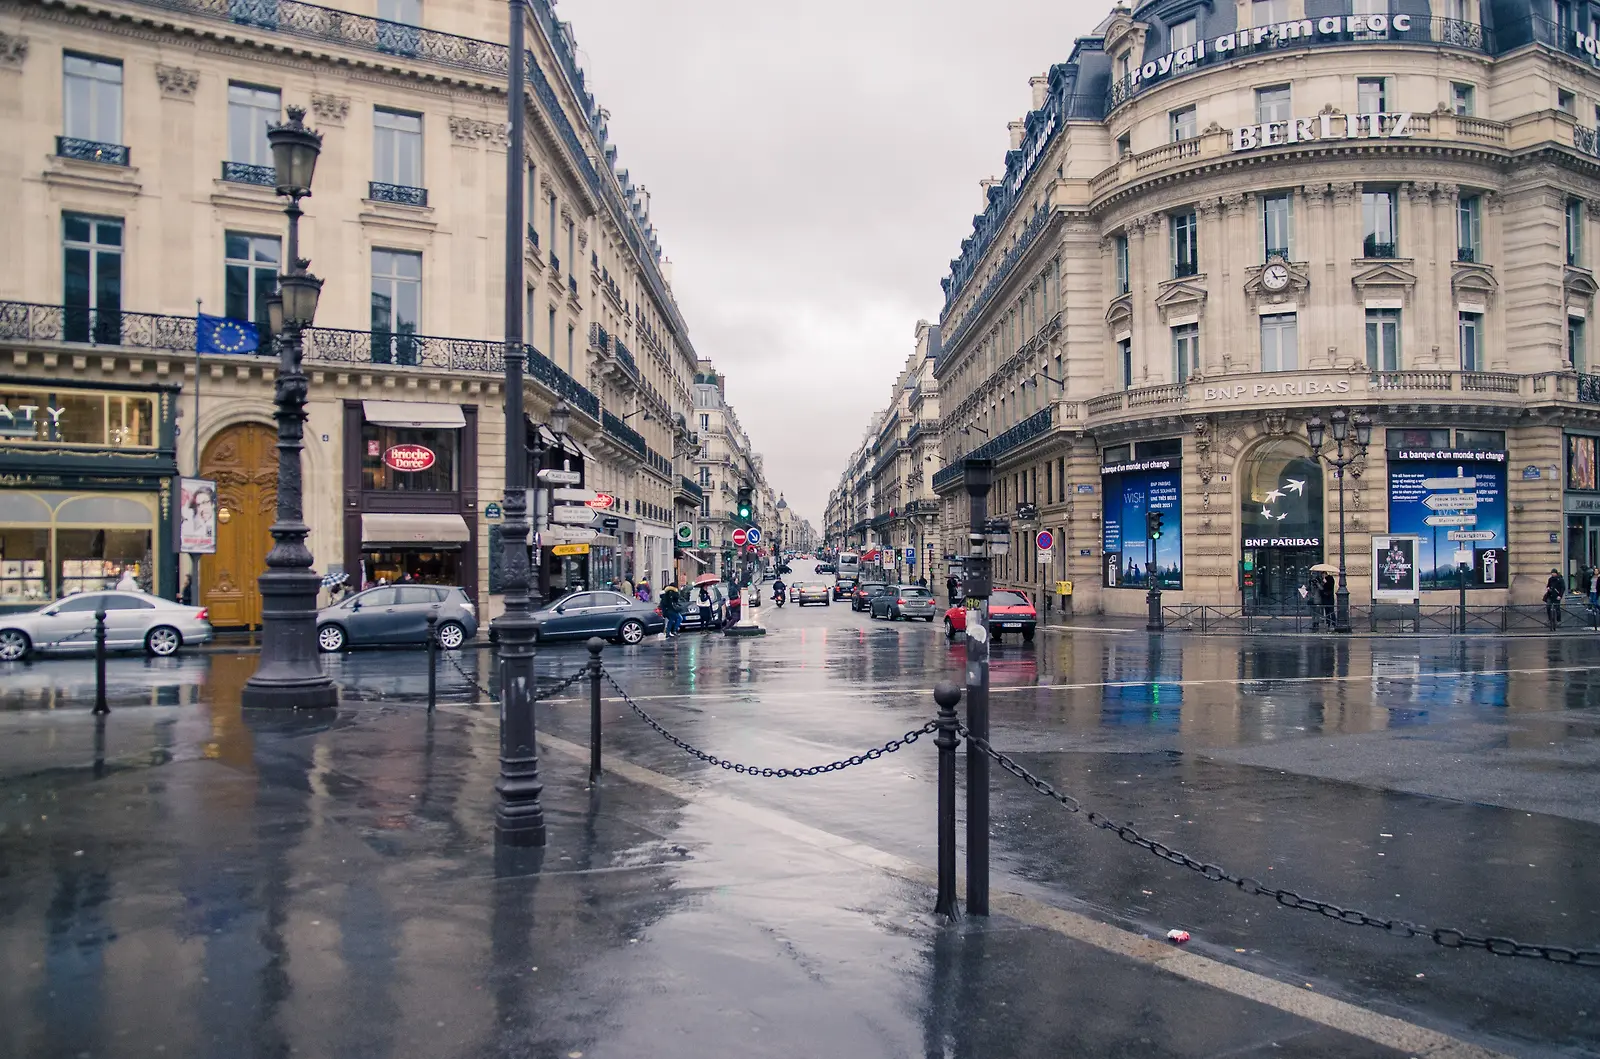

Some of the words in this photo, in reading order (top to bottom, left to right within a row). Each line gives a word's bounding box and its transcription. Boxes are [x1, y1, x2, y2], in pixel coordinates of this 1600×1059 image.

[1130, 39, 1205, 86] royal
[1215, 26, 1268, 53] air
[1280, 13, 1411, 41] maroc
[1231, 112, 1413, 151] BERLITZ
[1204, 385, 1247, 401] BNP
[1253, 380, 1351, 397] PARIBAS
[391, 449, 430, 460] Brioche
[1399, 451, 1408, 459] La
[1409, 451, 1435, 460] banque
[1436, 451, 1451, 459] d'un
[1453, 451, 1474, 459] monde
[1475, 451, 1485, 460] qui
[1485, 452, 1504, 461] change
[396, 458, 424, 468] Dorée
[1150, 460, 1170, 469] change
[1123, 492, 1145, 504] WISH
[1244, 538, 1269, 547] BNP
[1270, 538, 1319, 546] PARIBAS
